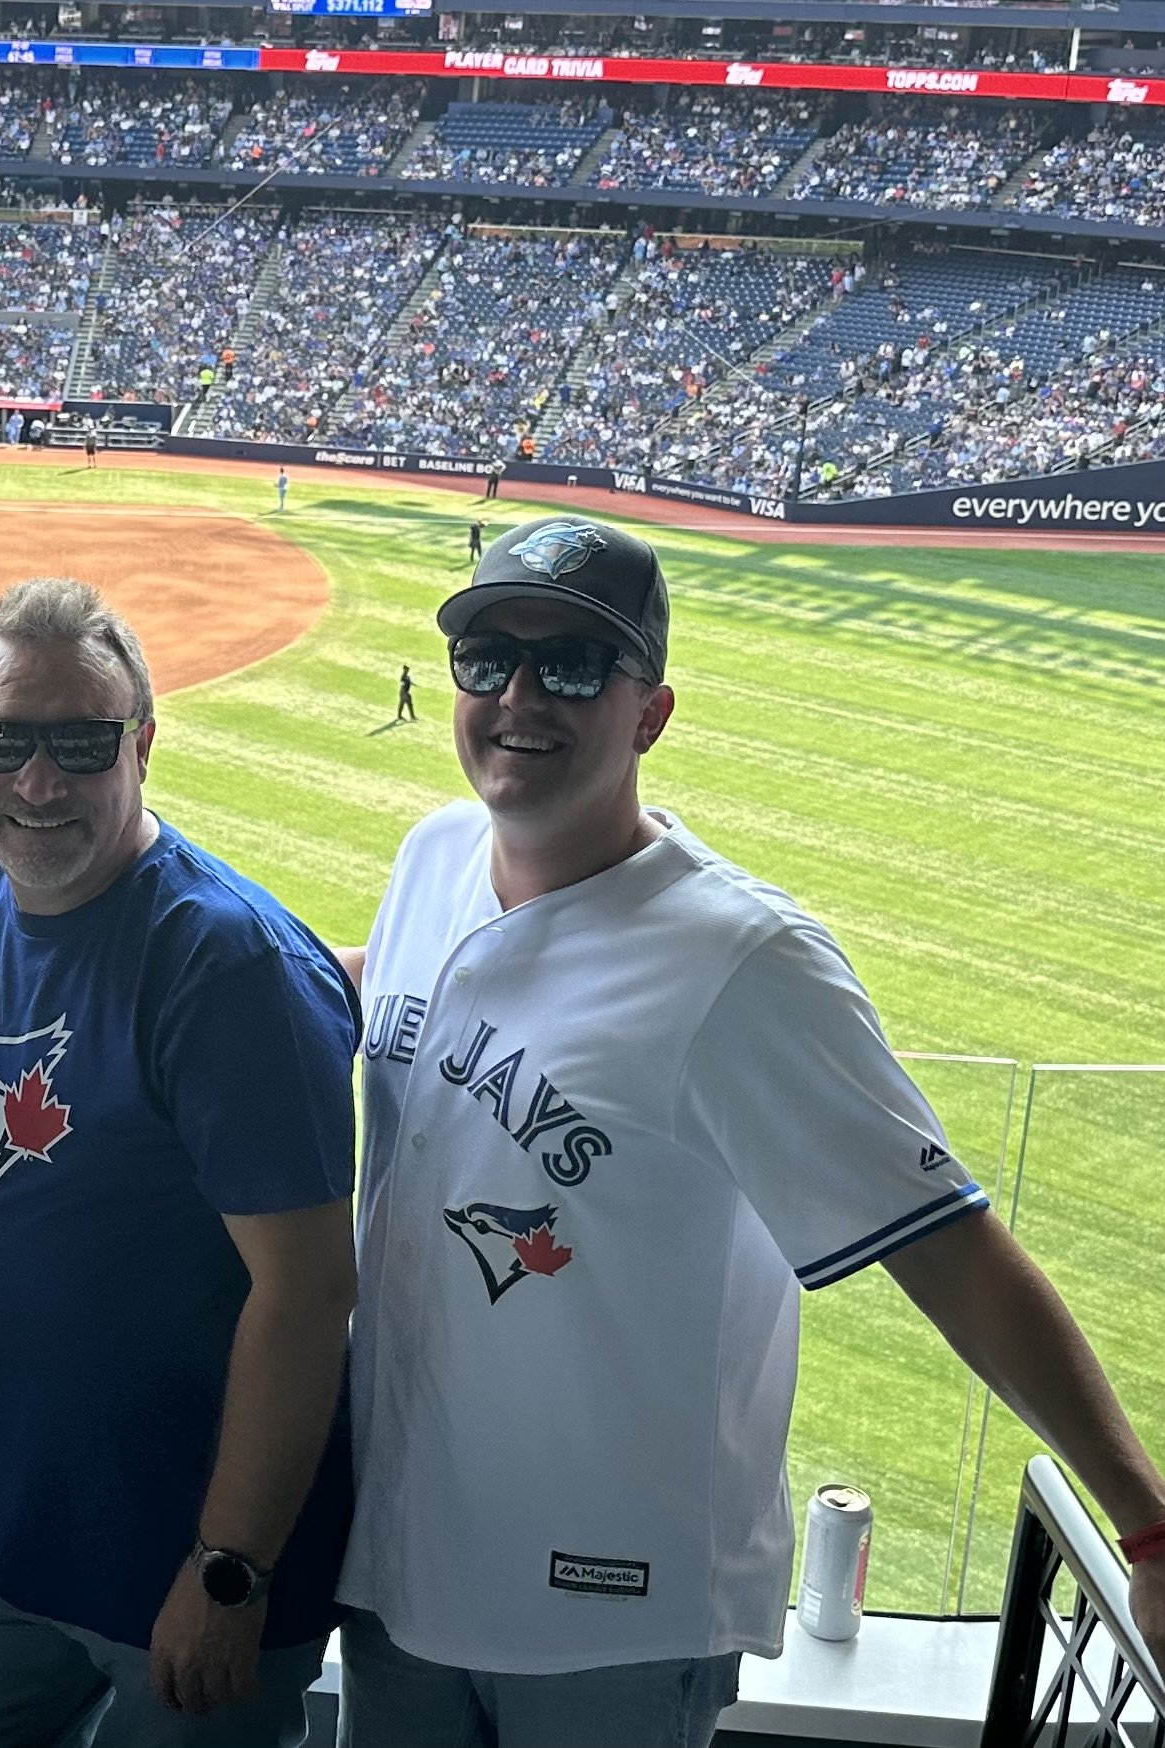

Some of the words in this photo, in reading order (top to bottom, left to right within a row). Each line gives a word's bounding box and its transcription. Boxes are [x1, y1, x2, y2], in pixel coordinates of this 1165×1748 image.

[444, 52, 504, 69] PLAYER
[503, 57, 549, 76] CARD
[551, 59, 604, 79] TRIVIA
[886, 70, 979, 92] TOPPS.COM
[383, 455, 407, 468] BET
[418, 461, 474, 475] BASELINE
[476, 465, 495, 477] BO
[612, 472, 647, 494] VISA
[749, 497, 785, 520] VISA
[952, 493, 1131, 524] everywhere
[365, 993, 427, 1065] UE
[439, 1020, 612, 1188] JAYS
[581, 1566, 639, 1584] Majestic
